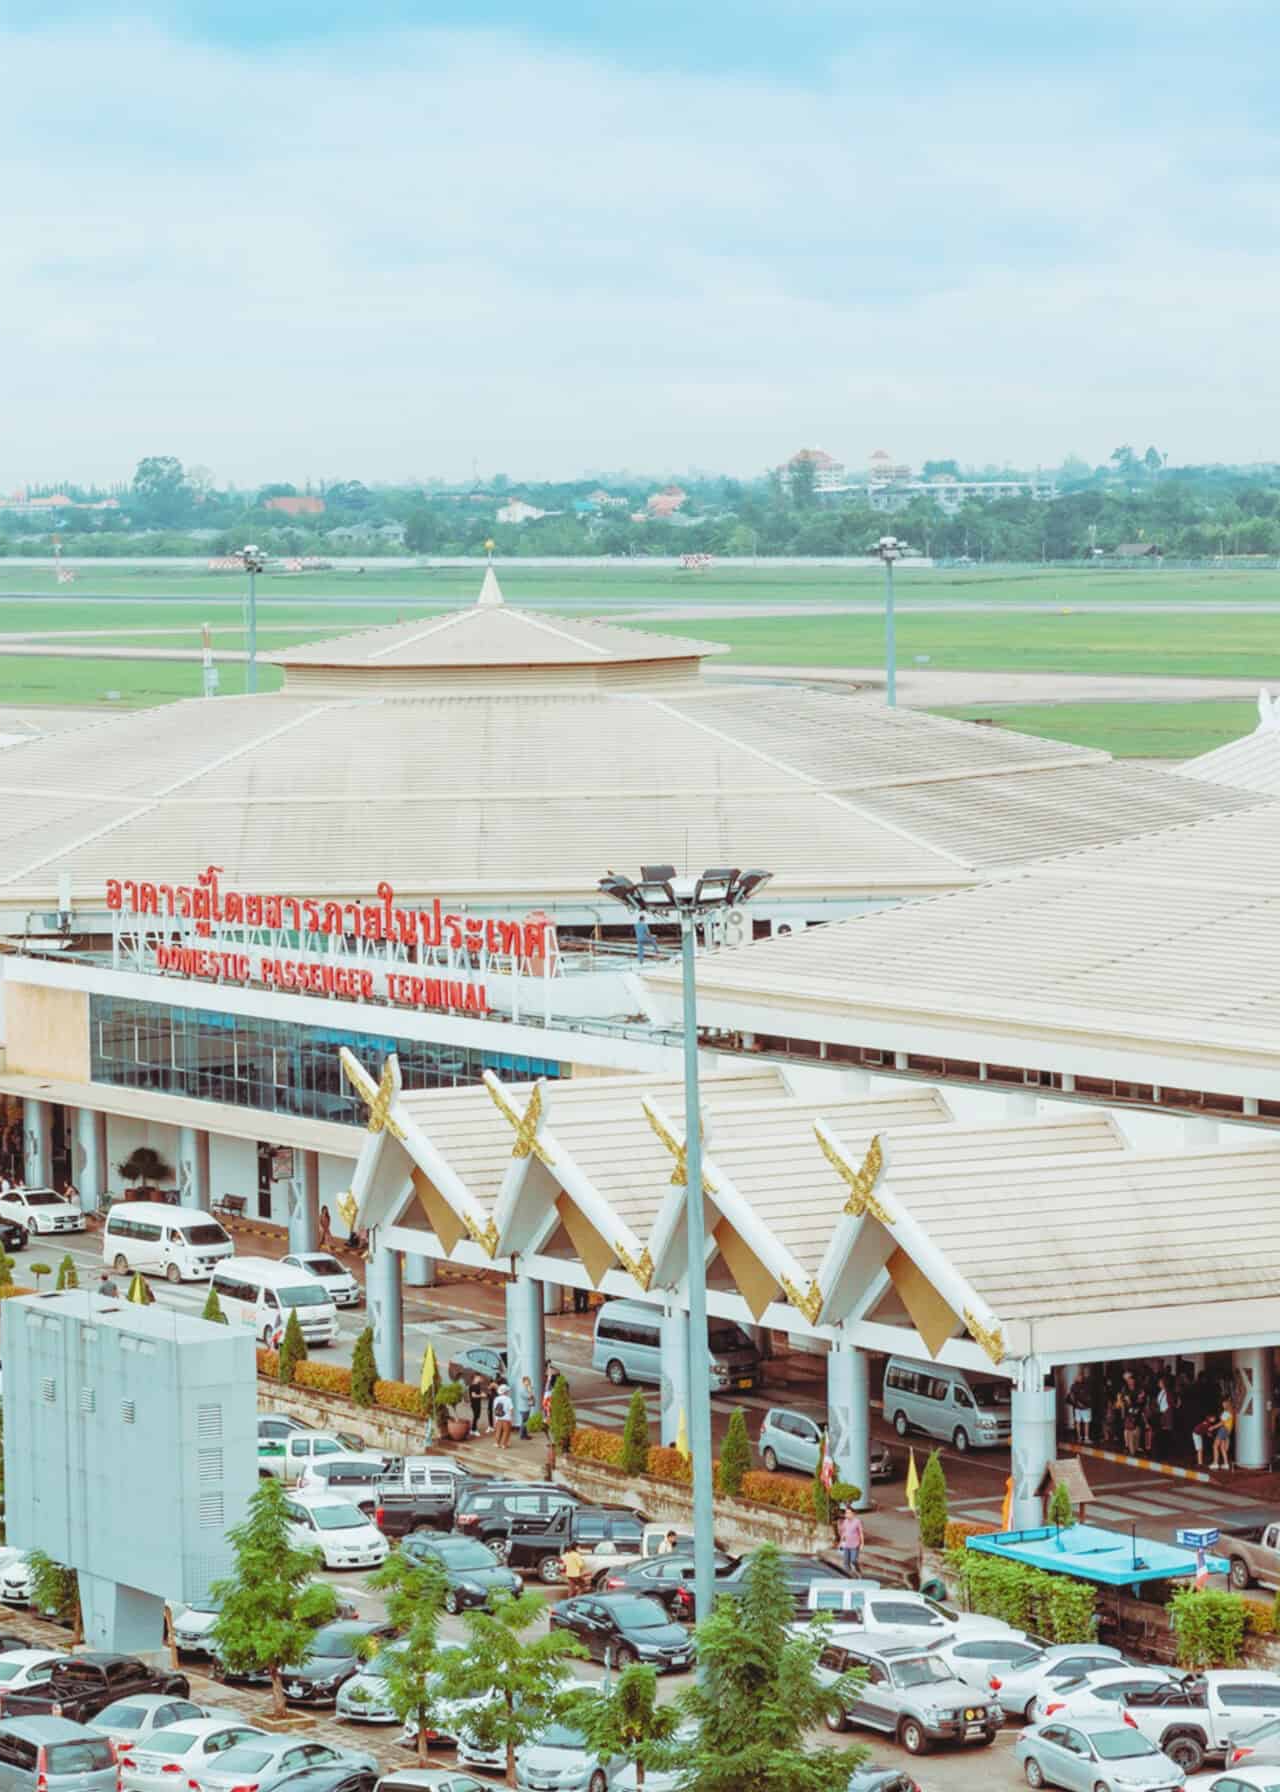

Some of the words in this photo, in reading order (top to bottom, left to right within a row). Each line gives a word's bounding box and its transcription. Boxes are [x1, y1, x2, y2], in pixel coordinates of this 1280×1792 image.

[105, 865, 547, 960] อาคารผู้โดยสารภายในประเทศ
[156, 945, 250, 981] DOMESTIC
[260, 957, 374, 1000] PASSENGER
[385, 973, 490, 1014] TERMINAL
